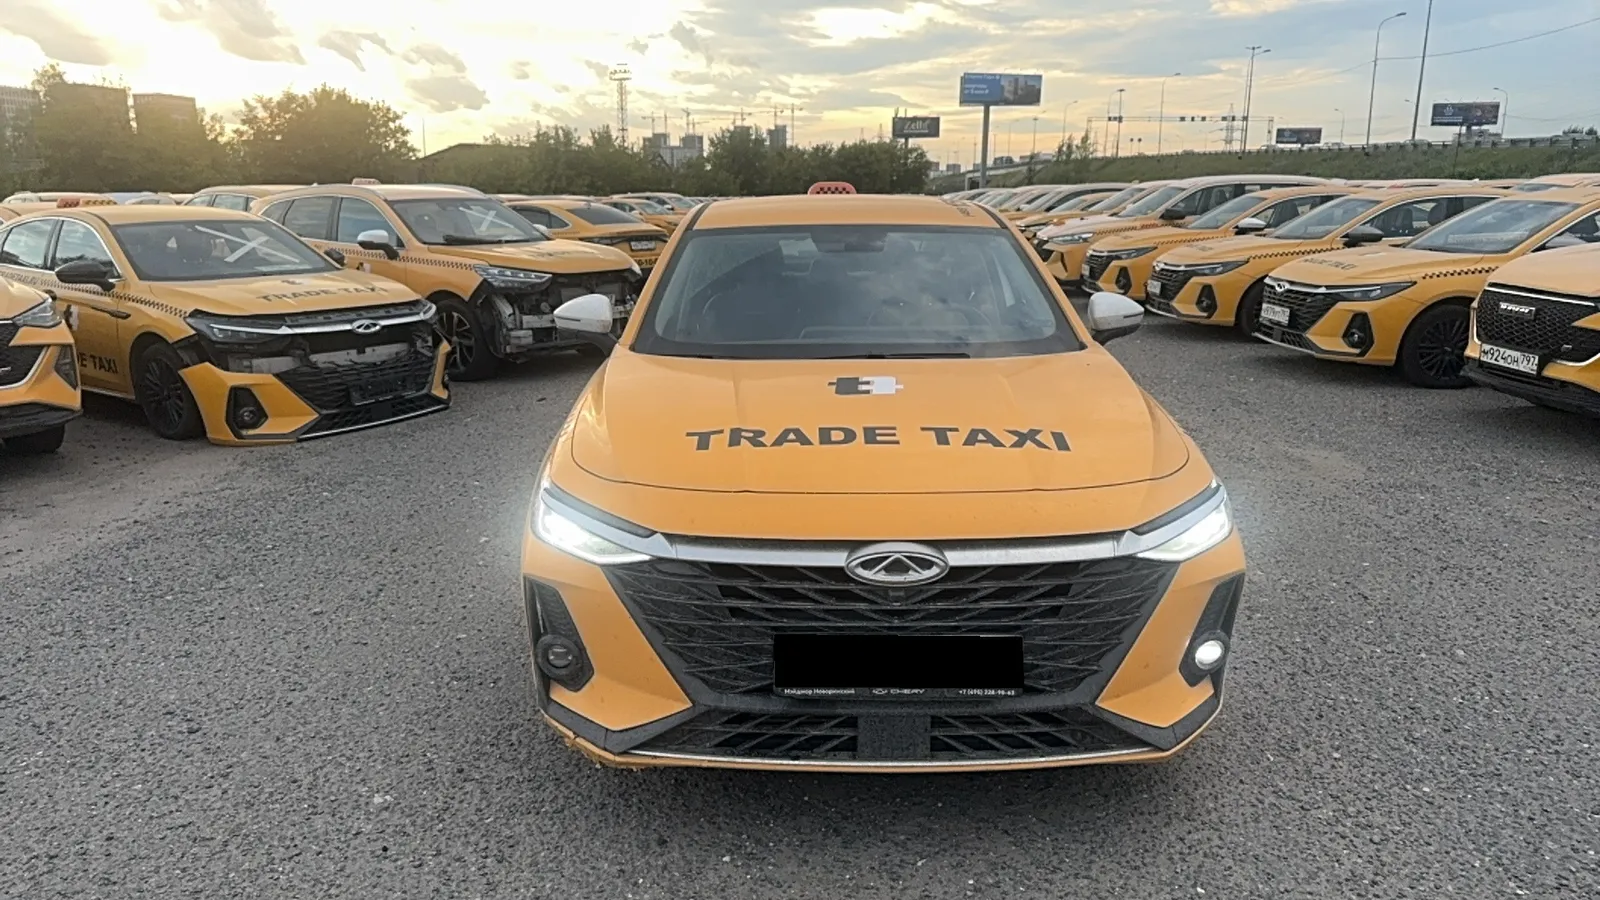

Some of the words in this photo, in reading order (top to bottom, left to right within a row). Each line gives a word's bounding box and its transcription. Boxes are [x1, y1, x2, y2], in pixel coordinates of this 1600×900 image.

[256, 289, 336, 302] TRADE
[338, 286, 389, 294] TAXI
[89, 354, 119, 374] TAXI
[686, 426, 900, 451] TRADE
[920, 426, 1072, 452] TAXI
[967, 688, 983, 696] (495)
